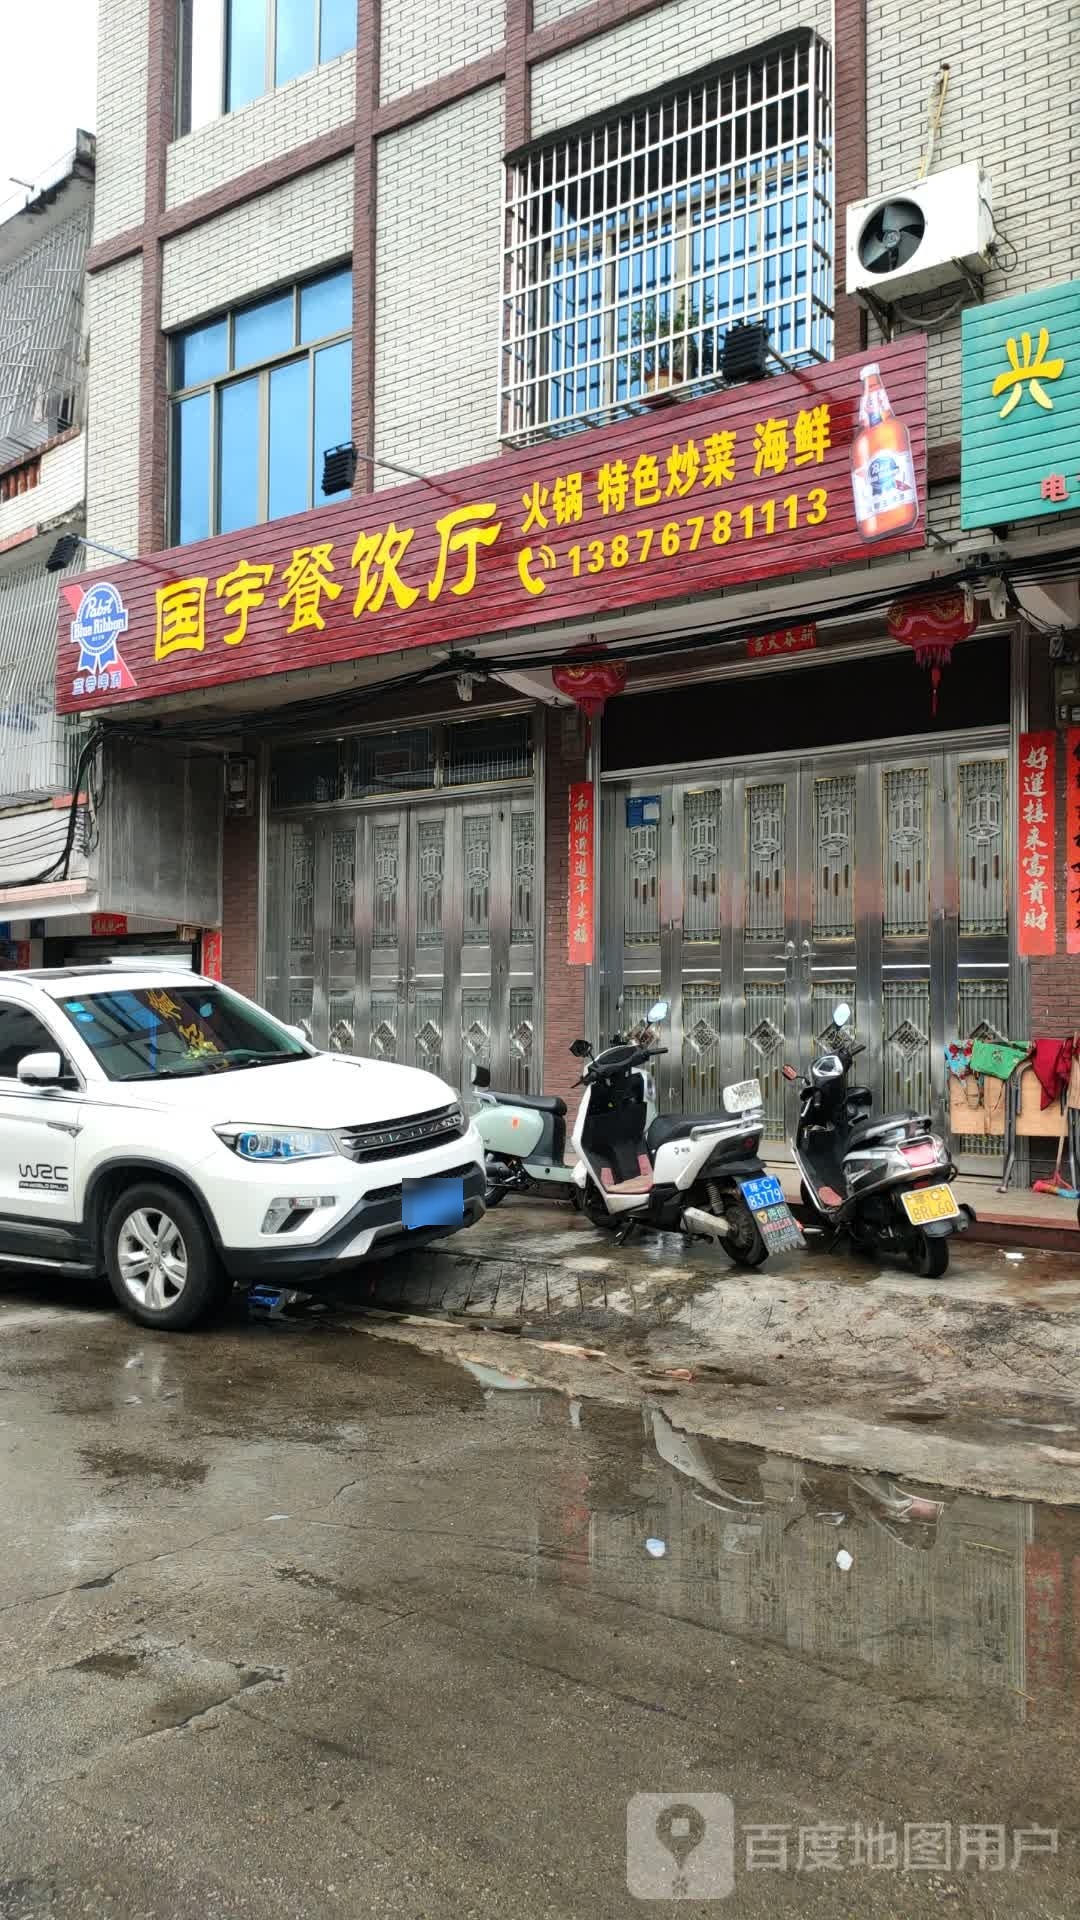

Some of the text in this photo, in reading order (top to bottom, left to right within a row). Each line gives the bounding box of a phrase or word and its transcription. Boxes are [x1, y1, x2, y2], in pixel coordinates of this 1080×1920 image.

[521, 404, 832, 533] 火锅 特色炒菜 海鲜
[1041, 473, 1080, 503] 电
[567, 487, 829, 577] 13876781113
[154, 503, 503, 662] 国宇餐饮厅
[85, 596, 114, 620] Pabst
[74, 616, 125, 639] Blue Ribbon
[18, 1163, 69, 1181] WRC
[749, 1189, 781, 1209] 83779
